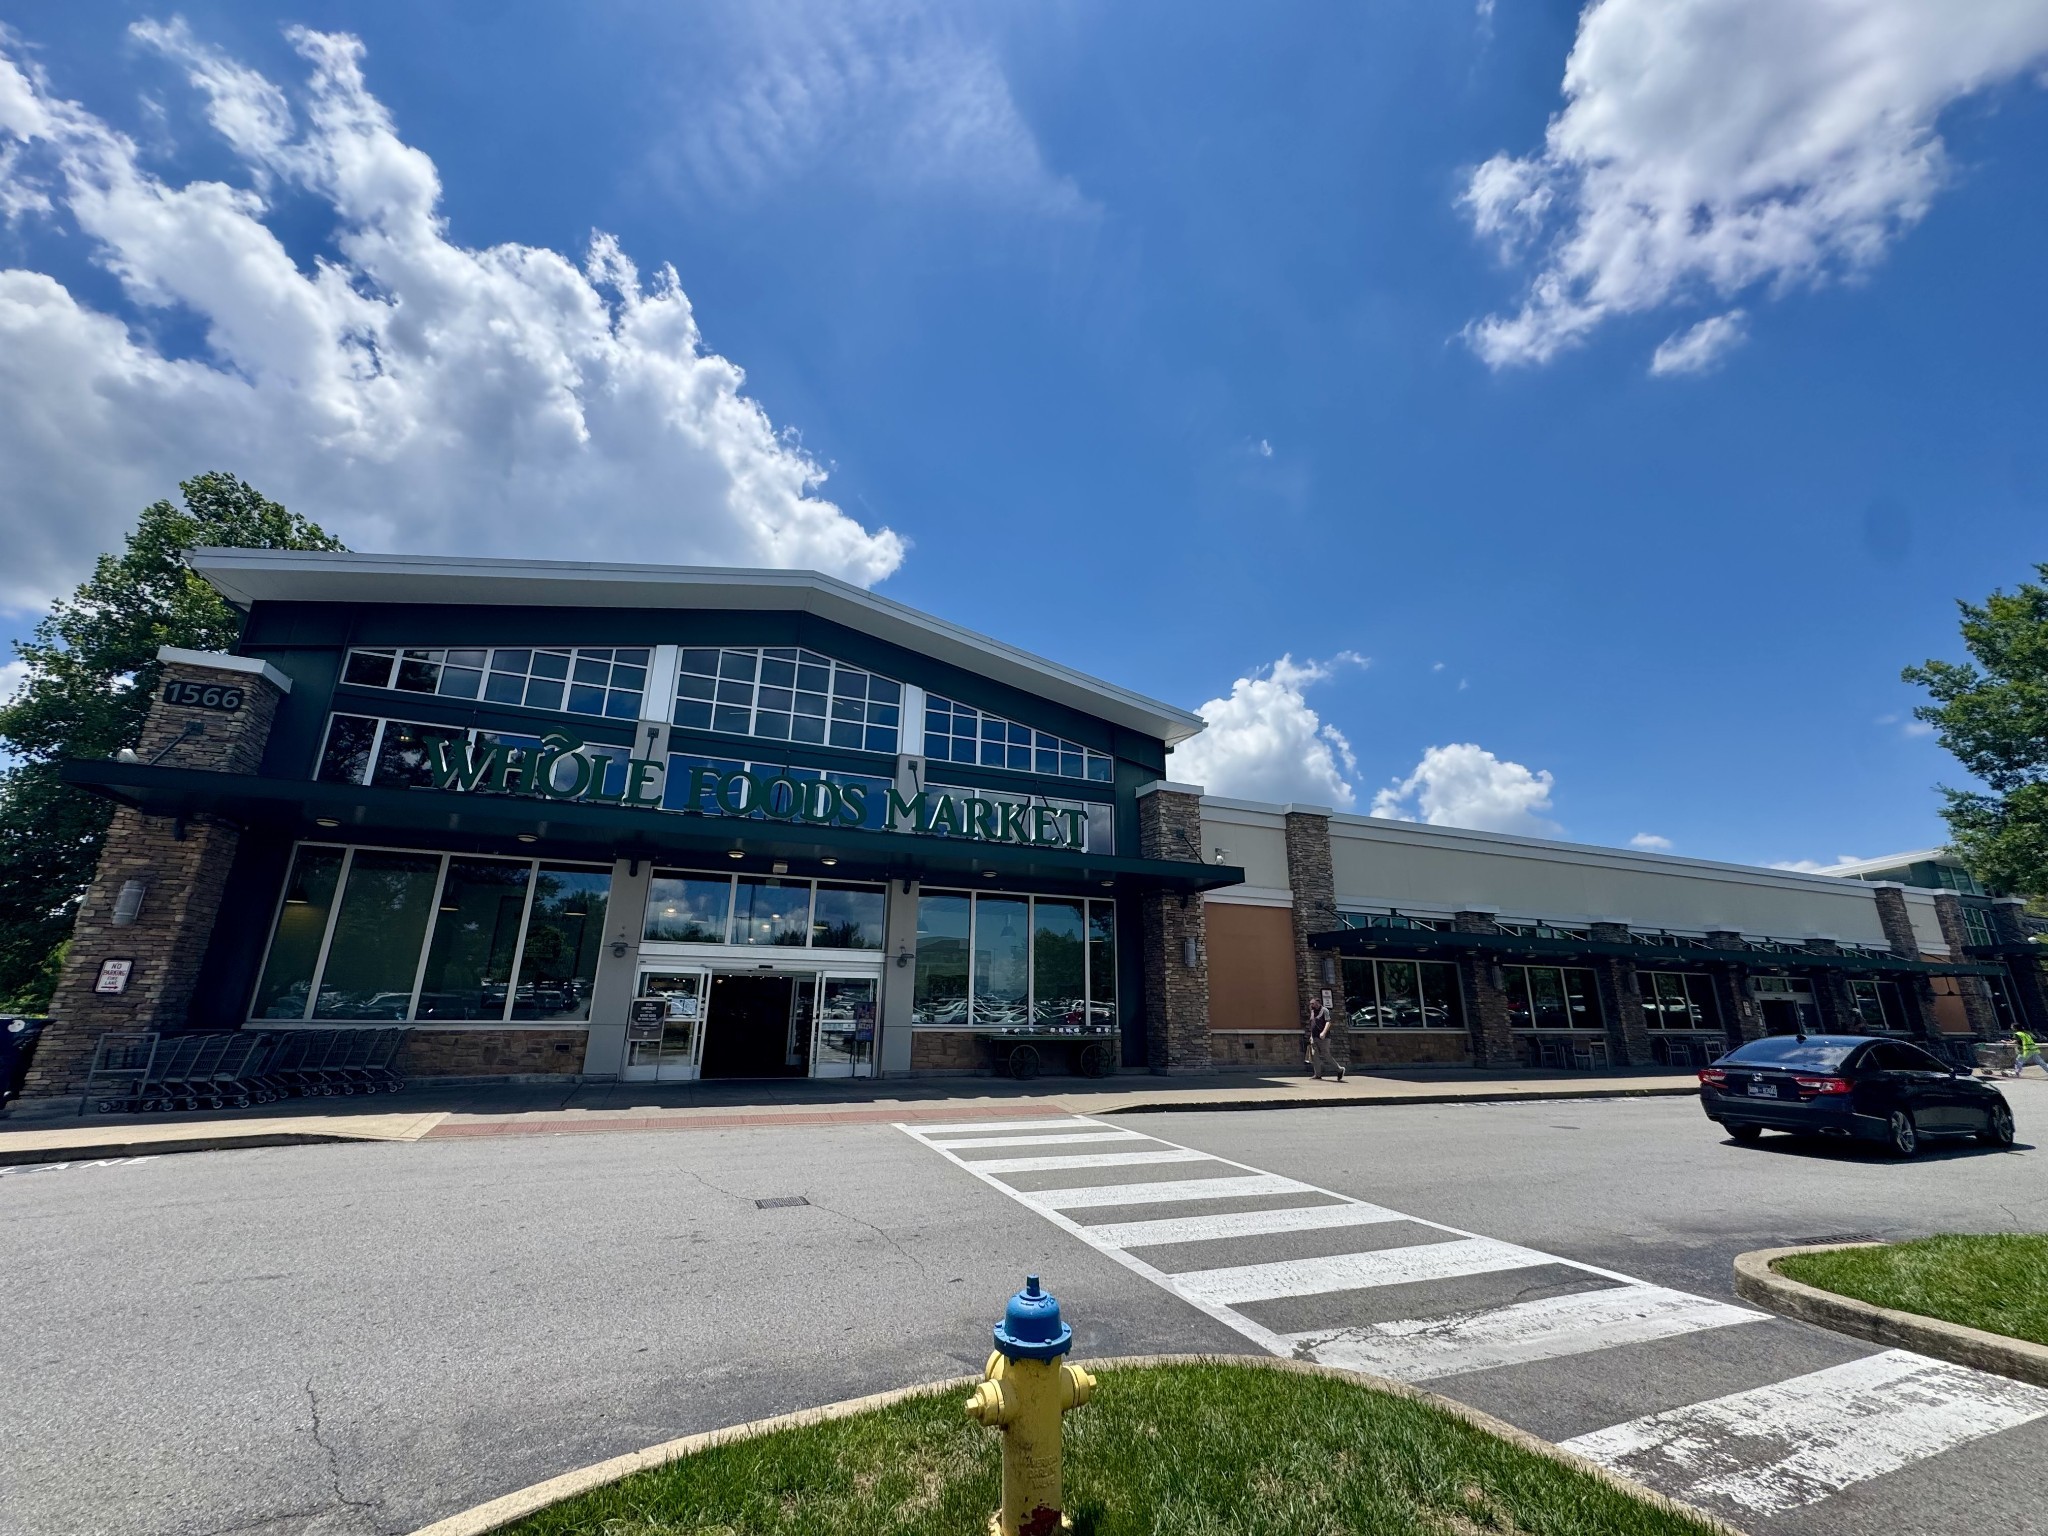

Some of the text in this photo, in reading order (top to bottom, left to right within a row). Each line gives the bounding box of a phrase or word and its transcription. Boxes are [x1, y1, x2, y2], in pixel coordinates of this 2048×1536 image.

[168, 683, 241, 709] 1566
[423, 726, 1090, 853] WHOLE FOODS MARKET
